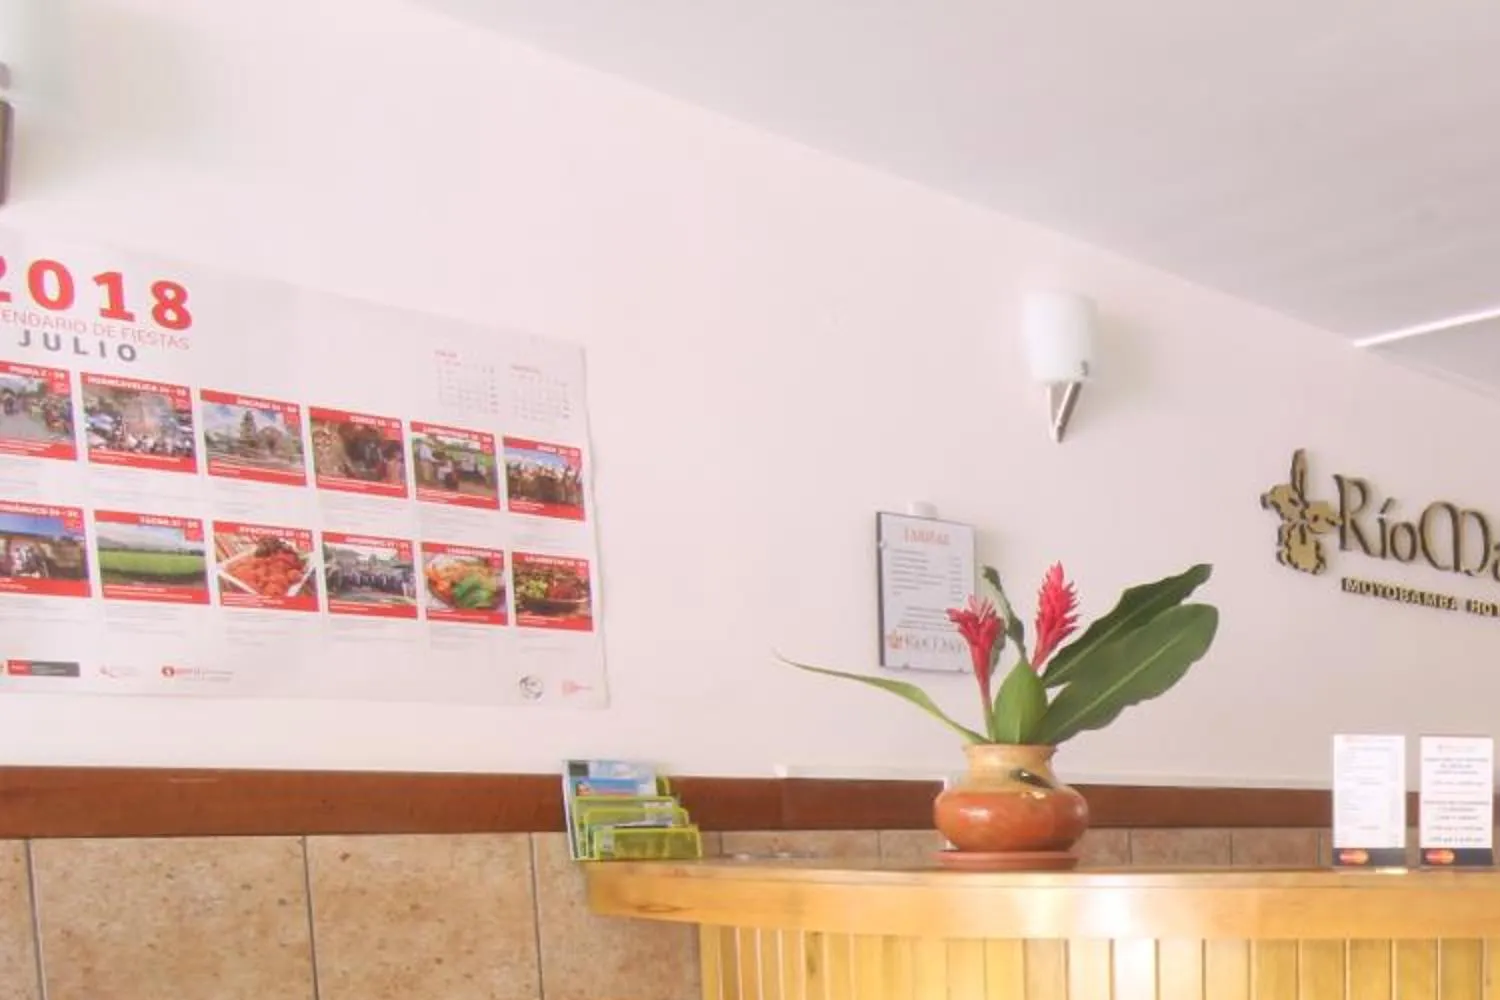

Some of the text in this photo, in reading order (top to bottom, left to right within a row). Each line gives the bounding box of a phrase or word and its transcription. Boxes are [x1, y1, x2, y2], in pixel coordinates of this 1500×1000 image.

[18, 329, 137, 363] JULIO
[93, 323, 117, 339] DE
[121, 327, 190, 351] FIESTAS
